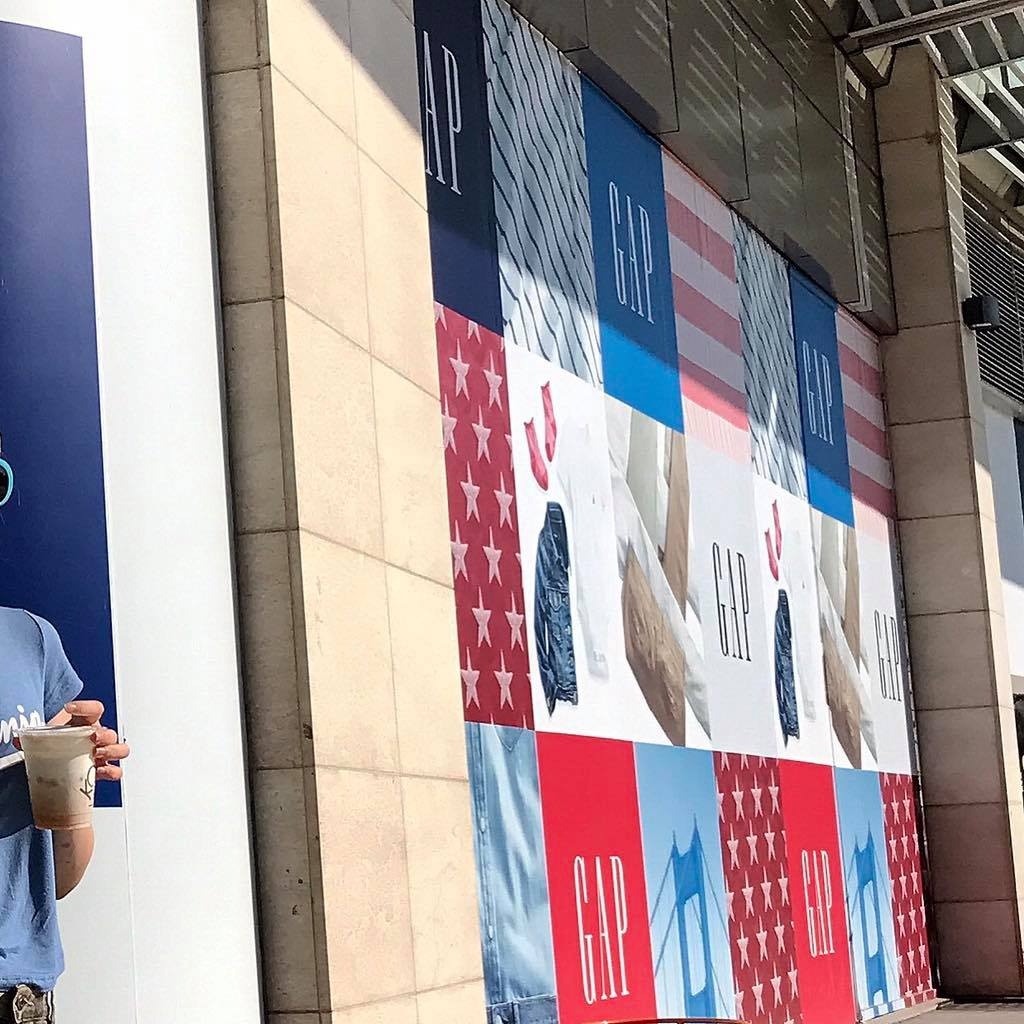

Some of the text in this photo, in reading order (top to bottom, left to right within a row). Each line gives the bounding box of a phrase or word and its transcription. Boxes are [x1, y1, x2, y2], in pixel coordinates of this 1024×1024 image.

[423, 30, 462, 196] AP
[608, 181, 655, 324] GAP
[802, 341, 834, 446] GAP
[712, 542, 752, 662] GAP
[874, 609, 902, 702] GAP
[573, 855, 630, 1005] GAP
[801, 849, 835, 958] GAP
